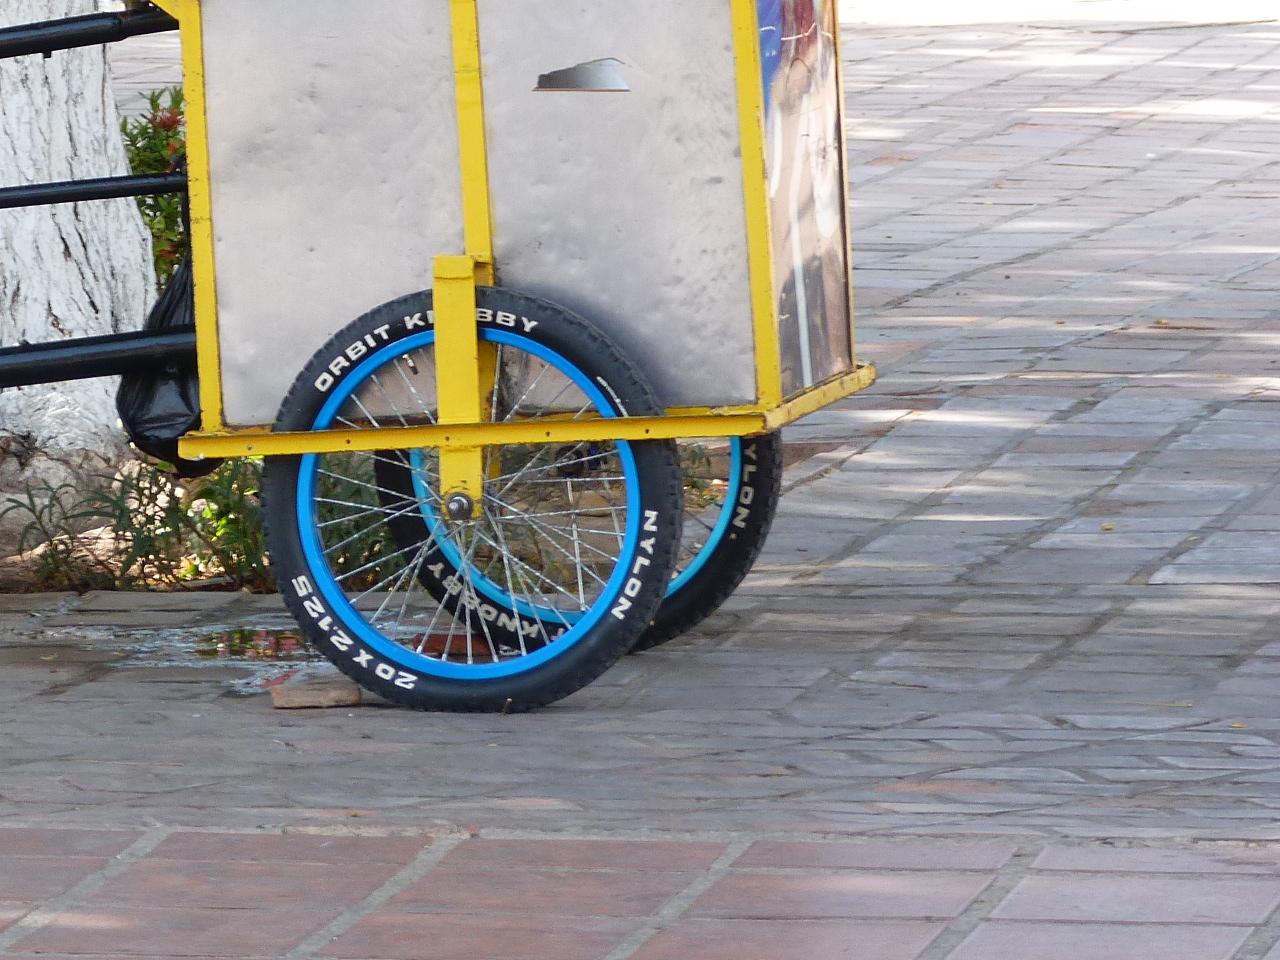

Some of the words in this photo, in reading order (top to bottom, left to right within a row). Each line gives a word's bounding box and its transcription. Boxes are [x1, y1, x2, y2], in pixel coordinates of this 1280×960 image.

[314, 323, 391, 393] ORBIT
[402, 307, 539, 334] KBBY
[732, 442, 758, 530] YLON
[610, 509, 659, 621] NYLON
[291, 574, 355, 652] 2.125
[375, 663, 419, 690] 20
